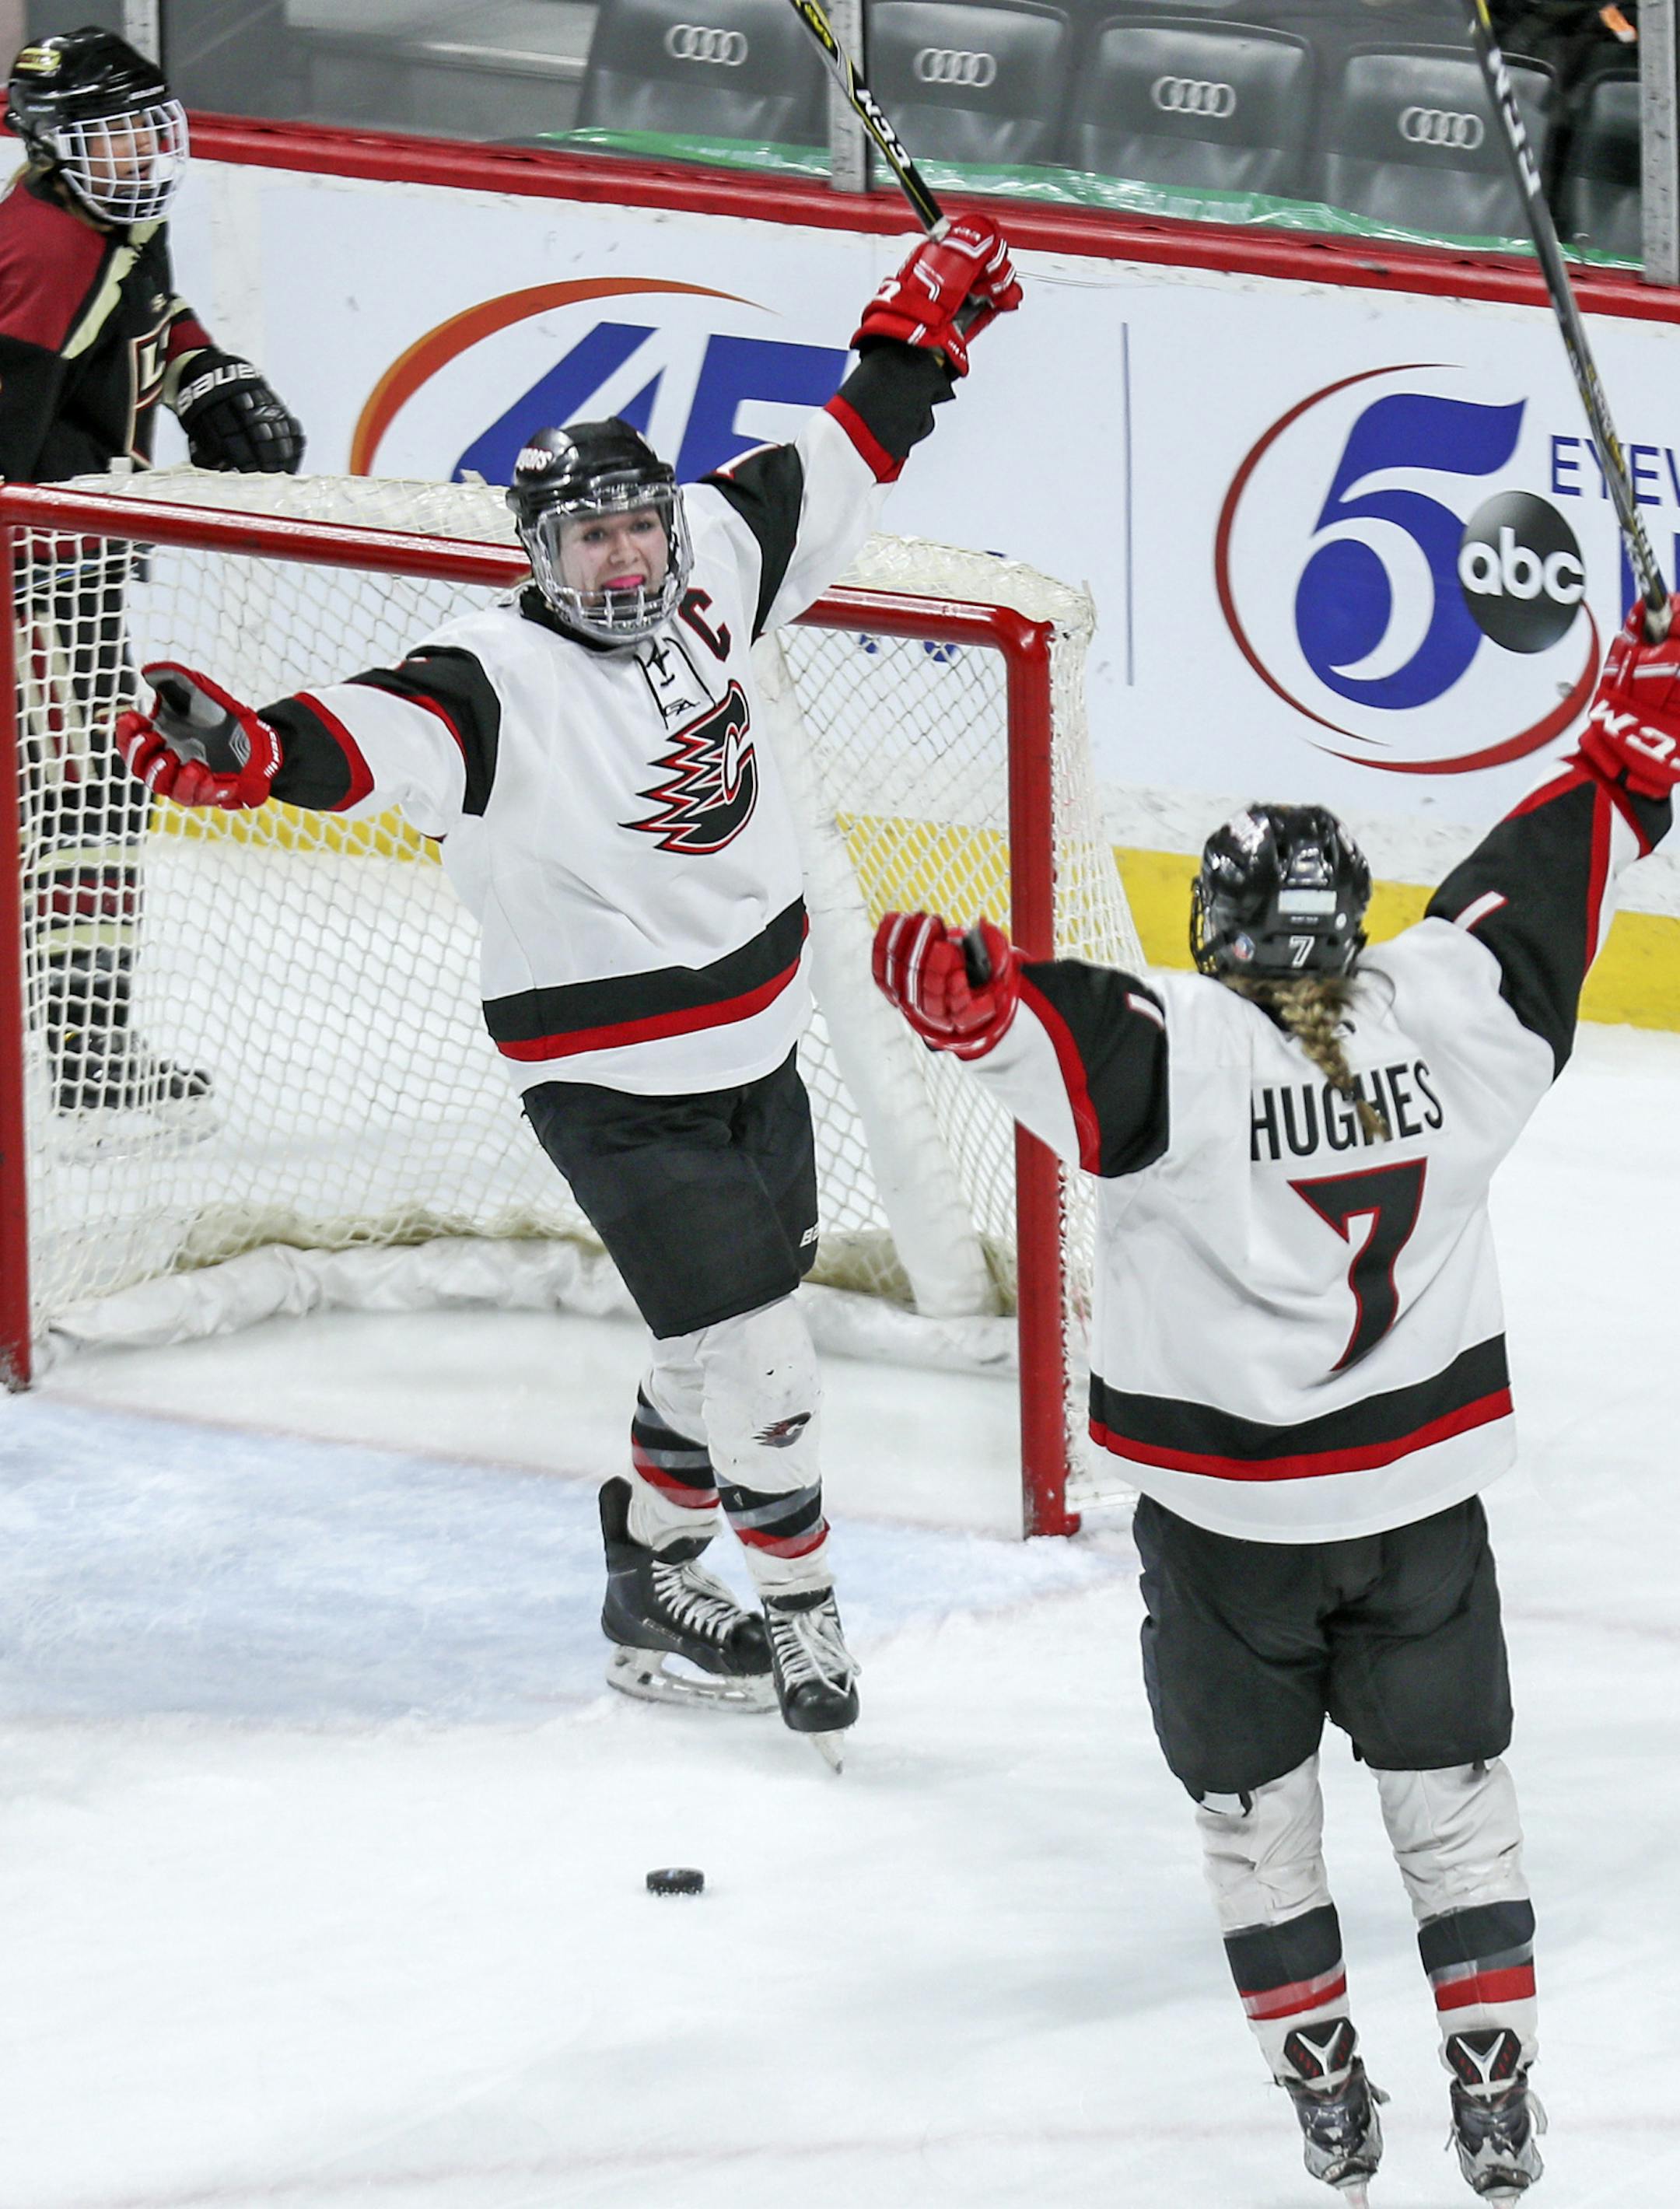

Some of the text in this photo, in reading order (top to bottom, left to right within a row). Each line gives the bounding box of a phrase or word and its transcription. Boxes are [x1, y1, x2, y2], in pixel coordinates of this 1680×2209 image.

[1295, 394, 1529, 710] 5
[1458, 526, 1586, 605] abc
[677, 588, 731, 663] C
[1289, 935, 1314, 968] 7
[1250, 1059, 1444, 1161] HUGHES
[1286, 1156, 1429, 1372] 7
